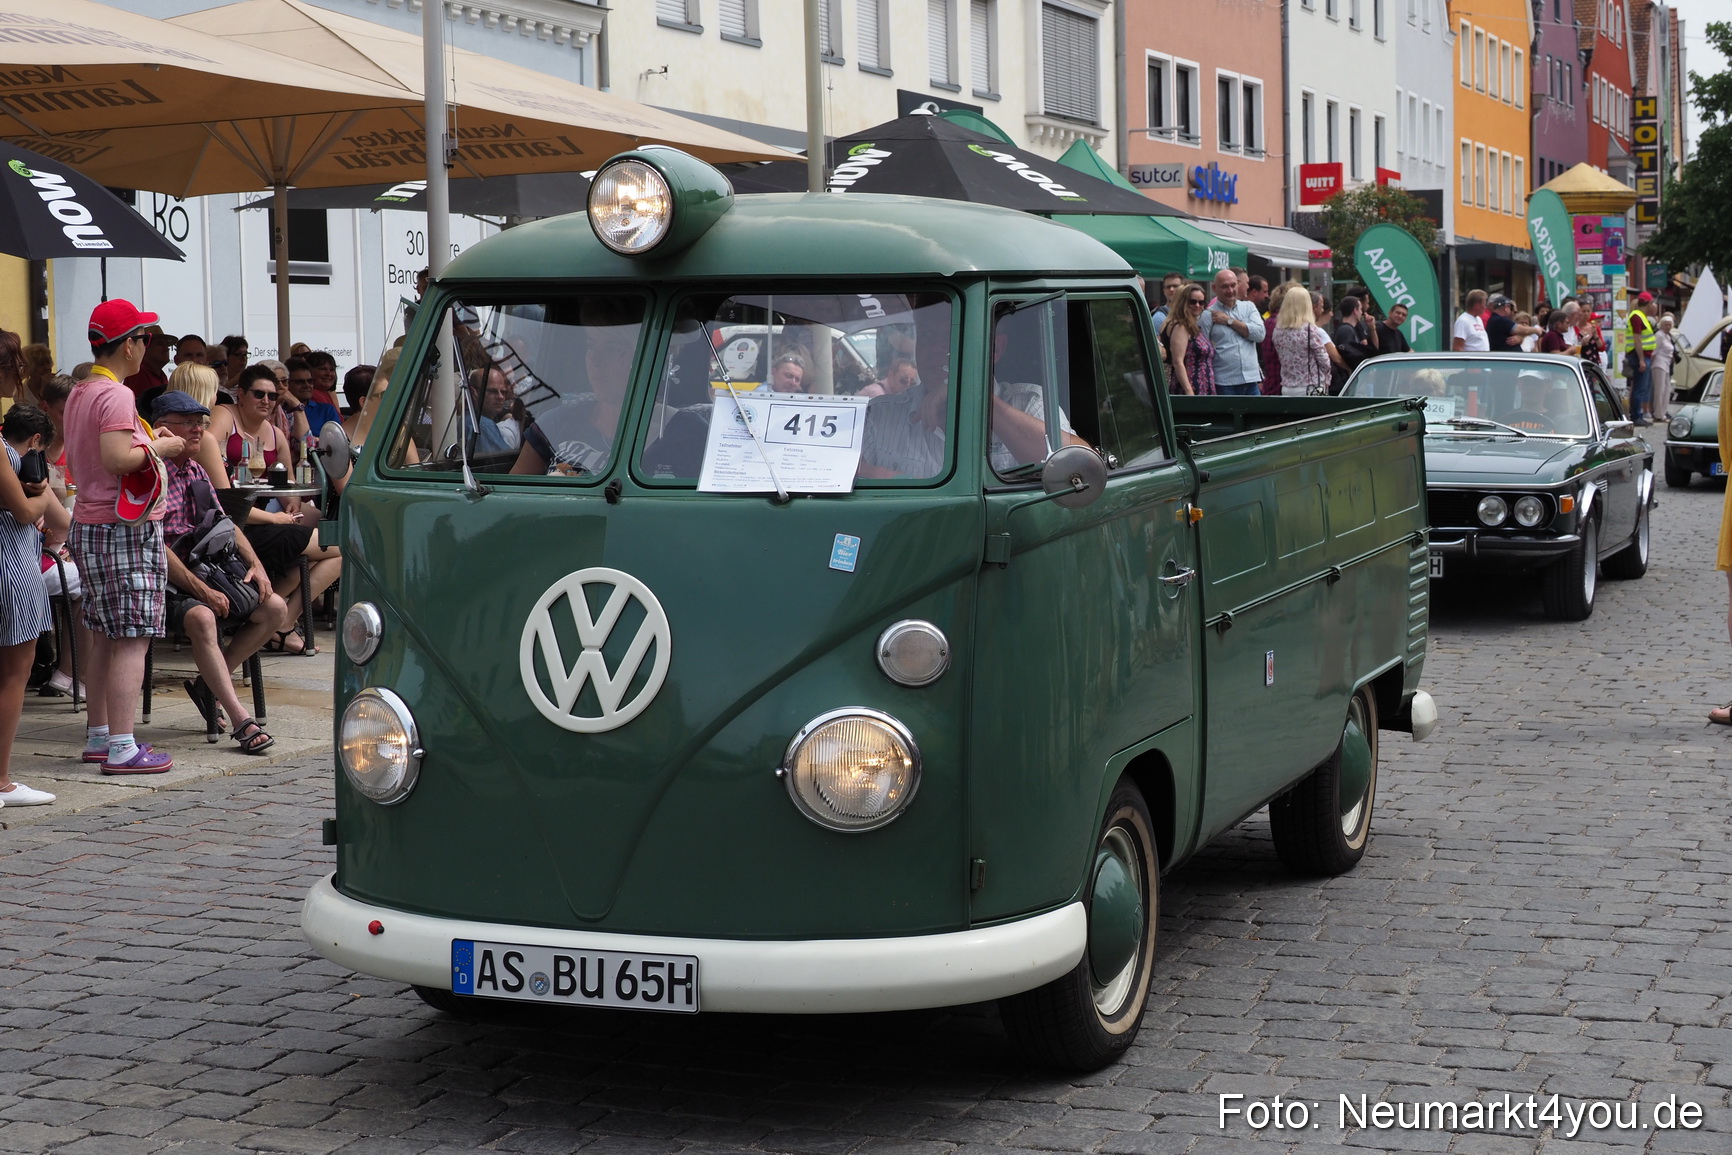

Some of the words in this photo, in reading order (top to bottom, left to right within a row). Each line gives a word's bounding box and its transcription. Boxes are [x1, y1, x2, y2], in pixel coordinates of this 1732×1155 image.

[1635, 99, 1657, 223] HOTEL
[1305, 176, 1335, 188] WITT
[406, 230, 425, 256] 30
[1213, 250, 1230, 270] DEKRA
[1425, 403, 1445, 413] 326
[783, 413, 838, 438] 415
[520, 567, 672, 733] VW
[459, 972, 468, 985] D
[476, 949, 525, 993] AS
[553, 954, 605, 999] BU
[615, 959, 694, 1005] 65H
